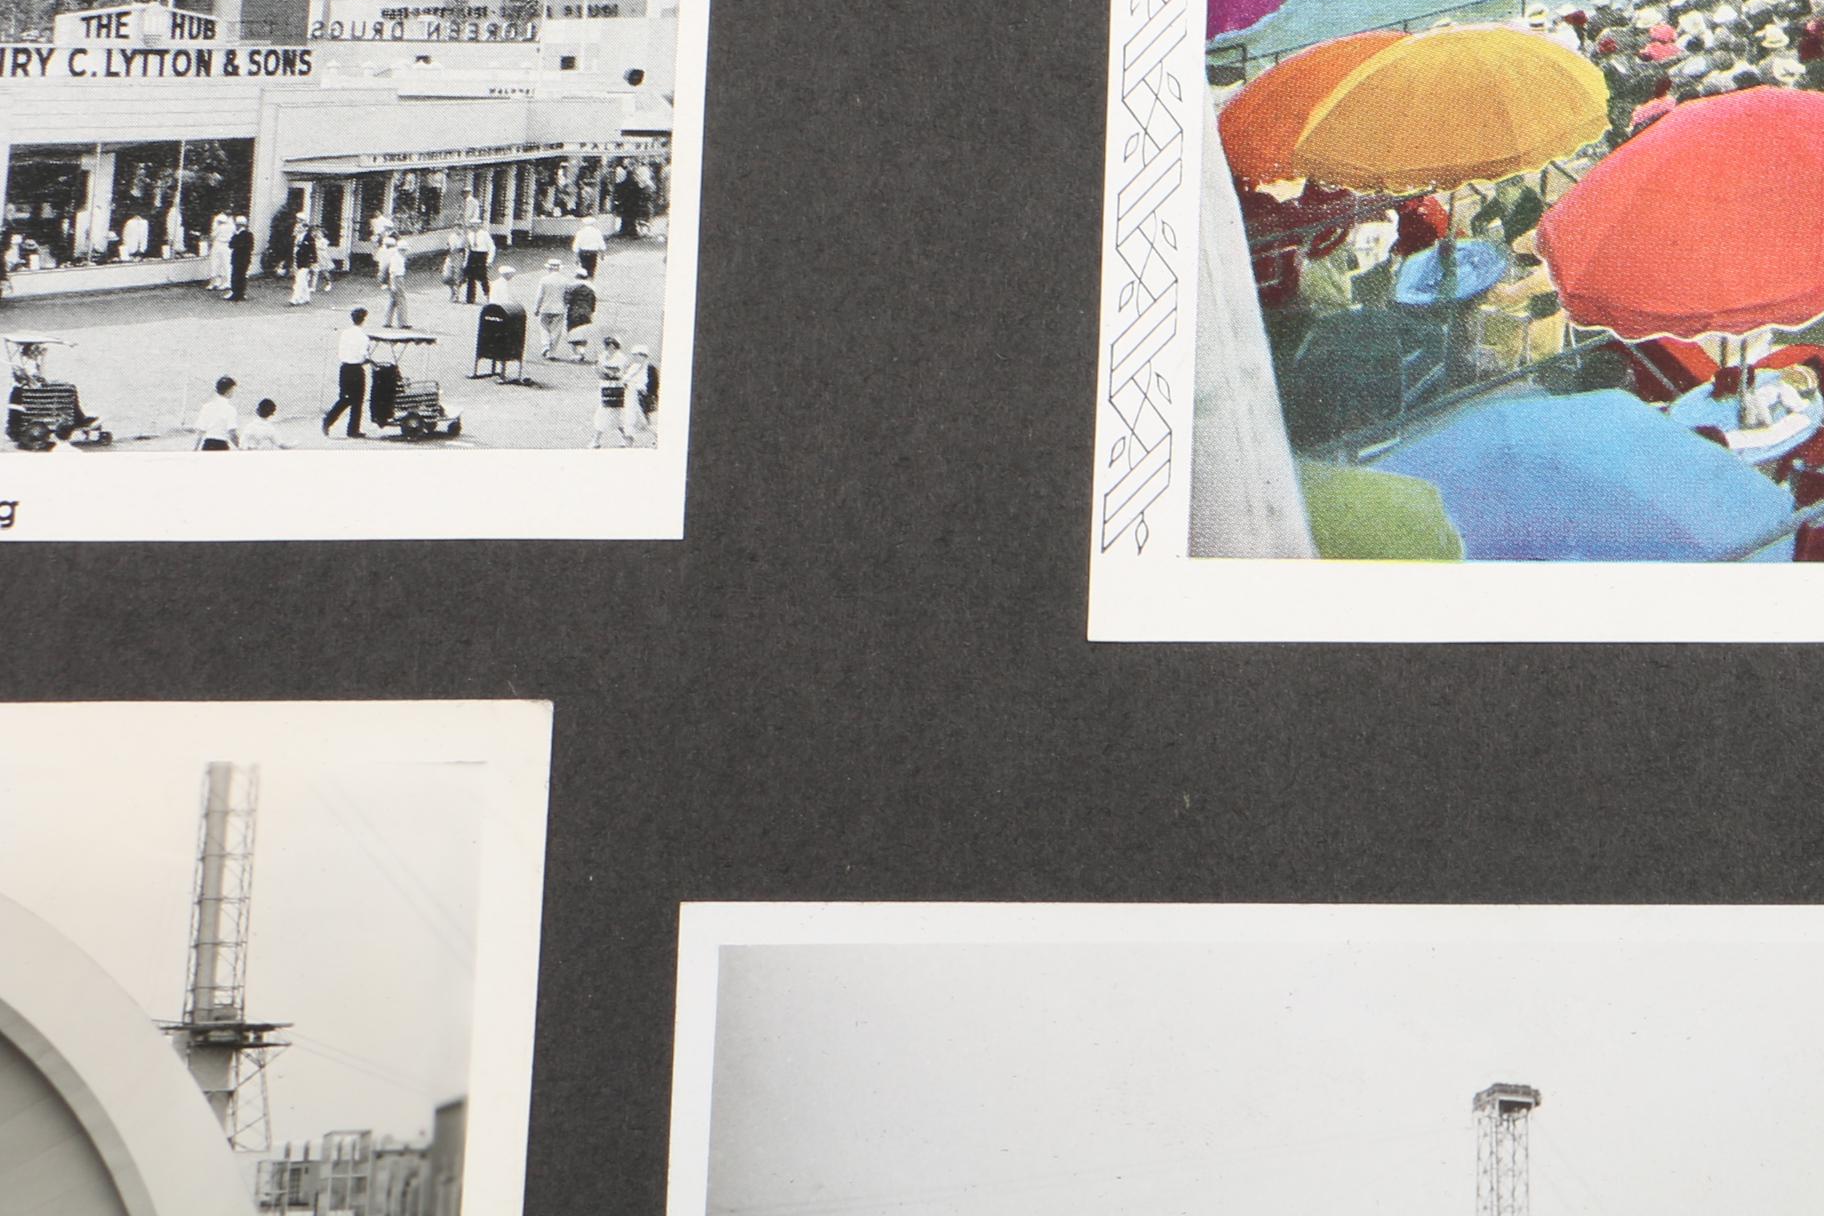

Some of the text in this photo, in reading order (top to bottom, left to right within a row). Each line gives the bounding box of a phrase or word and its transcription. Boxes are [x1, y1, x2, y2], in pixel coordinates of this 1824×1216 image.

[81, 11, 217, 41] THE HUB
[67, 48, 98, 77] C.
[106, 47, 213, 77] LYTTON
[223, 47, 240, 77] &
[247, 48, 312, 77] SONS
